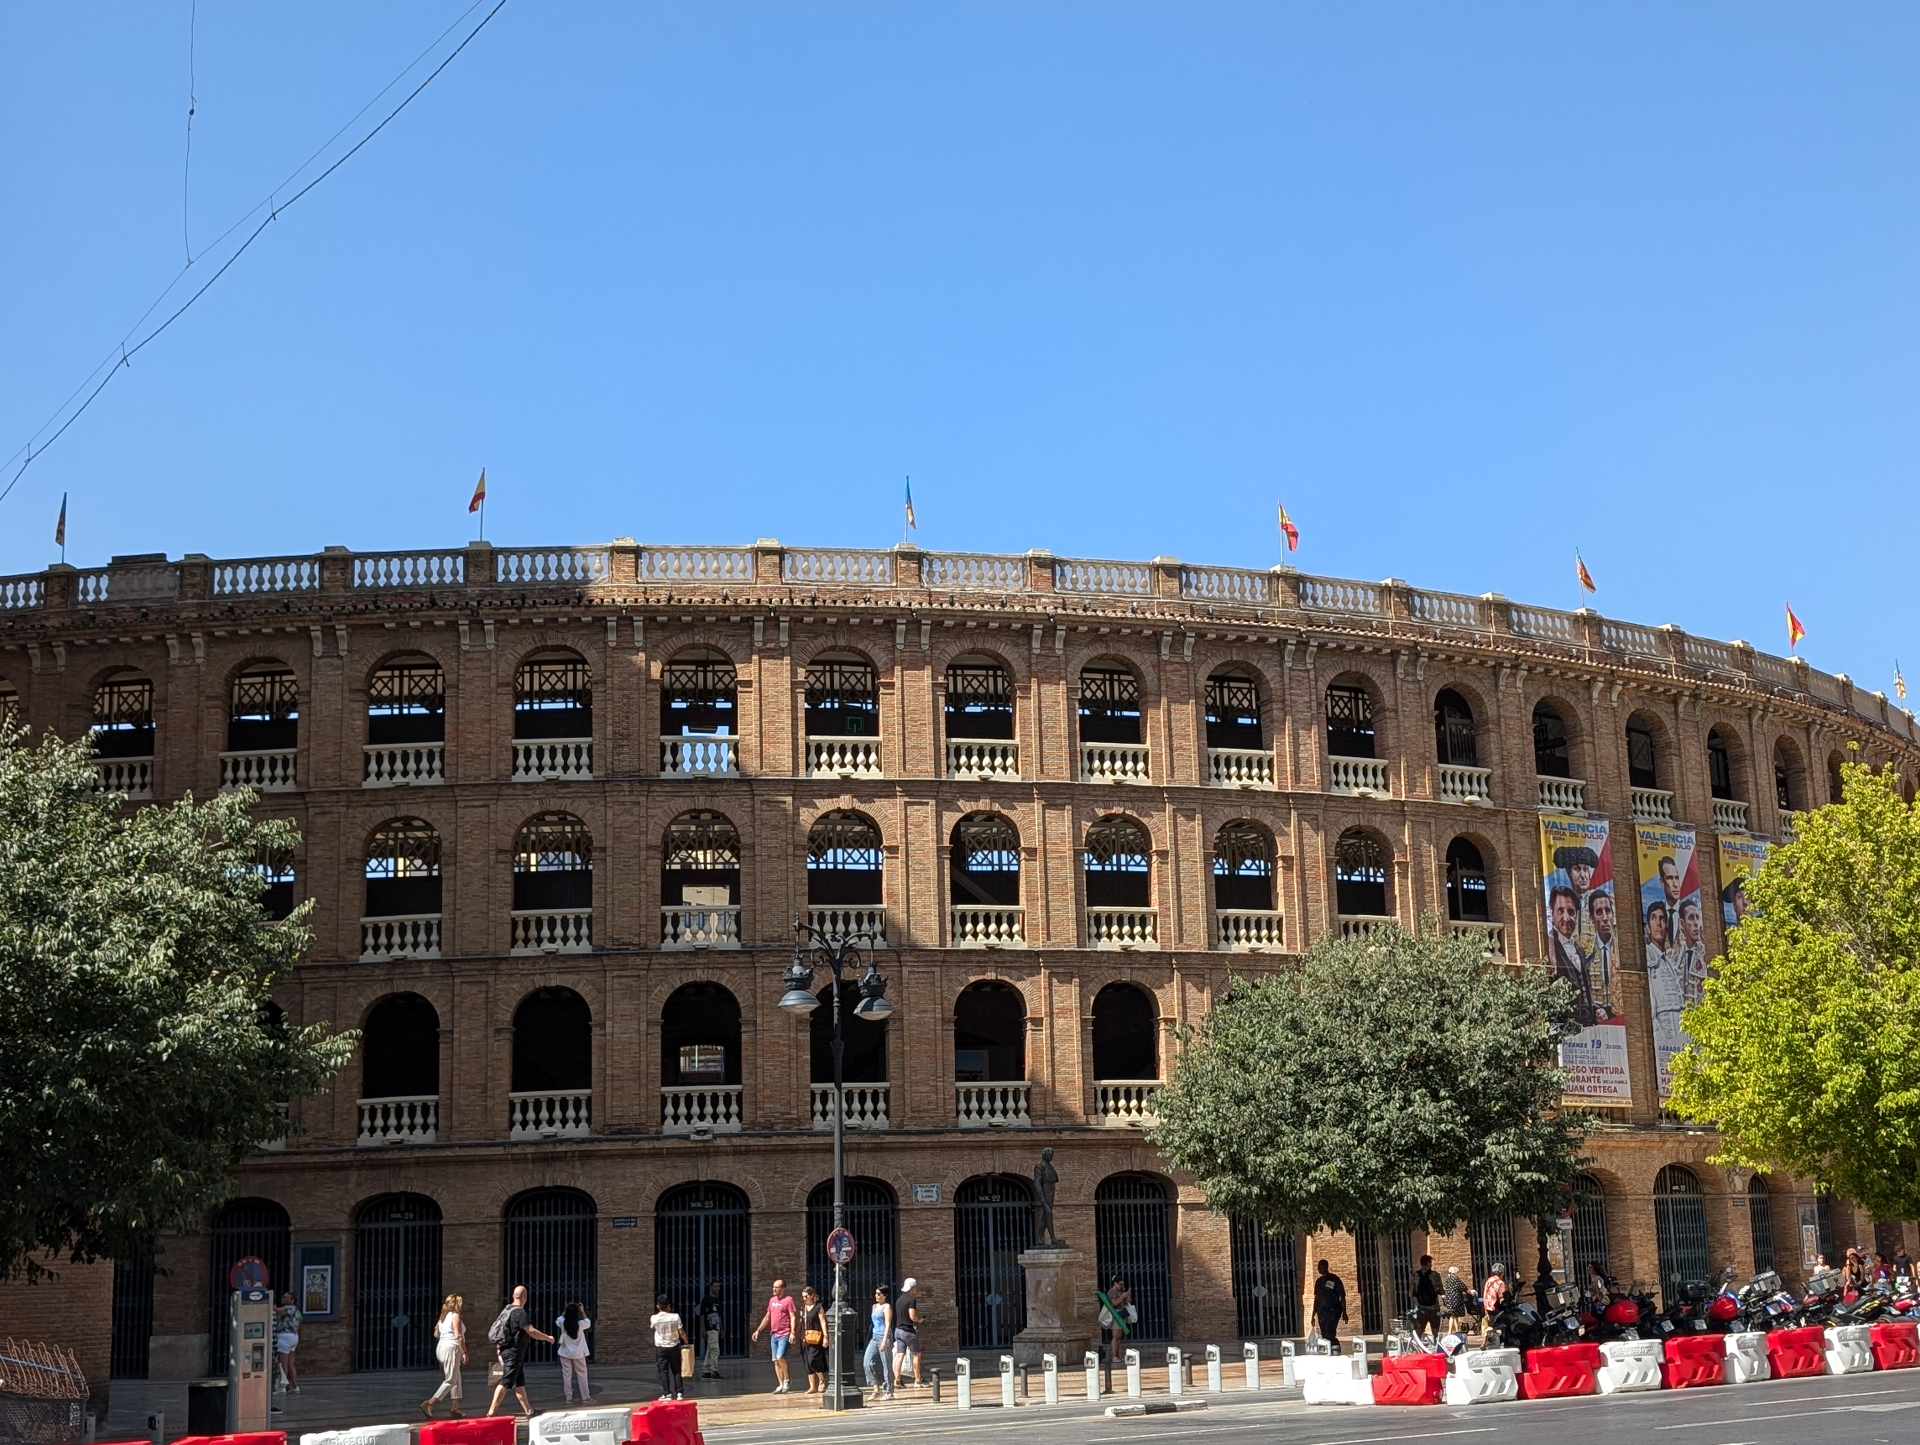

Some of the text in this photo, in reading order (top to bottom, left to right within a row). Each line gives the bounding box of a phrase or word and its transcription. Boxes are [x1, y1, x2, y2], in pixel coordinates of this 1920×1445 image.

[1542, 820, 1608, 835] VALENCIA
[1544, 829, 1567, 837] FERIA
[1581, 832, 1604, 840] JULIO
[1637, 830, 1695, 845] VALENCIA
[1640, 839, 1659, 847] FERIA
[1720, 840, 1766, 854] VALENCI
[1750, 852, 1768, 860] JULIO
[1591, 1039, 1602, 1049] 19
[1589, 1066, 1625, 1075] VENTURA
[1564, 1085, 1618, 1094] JUAN ORTEGA
